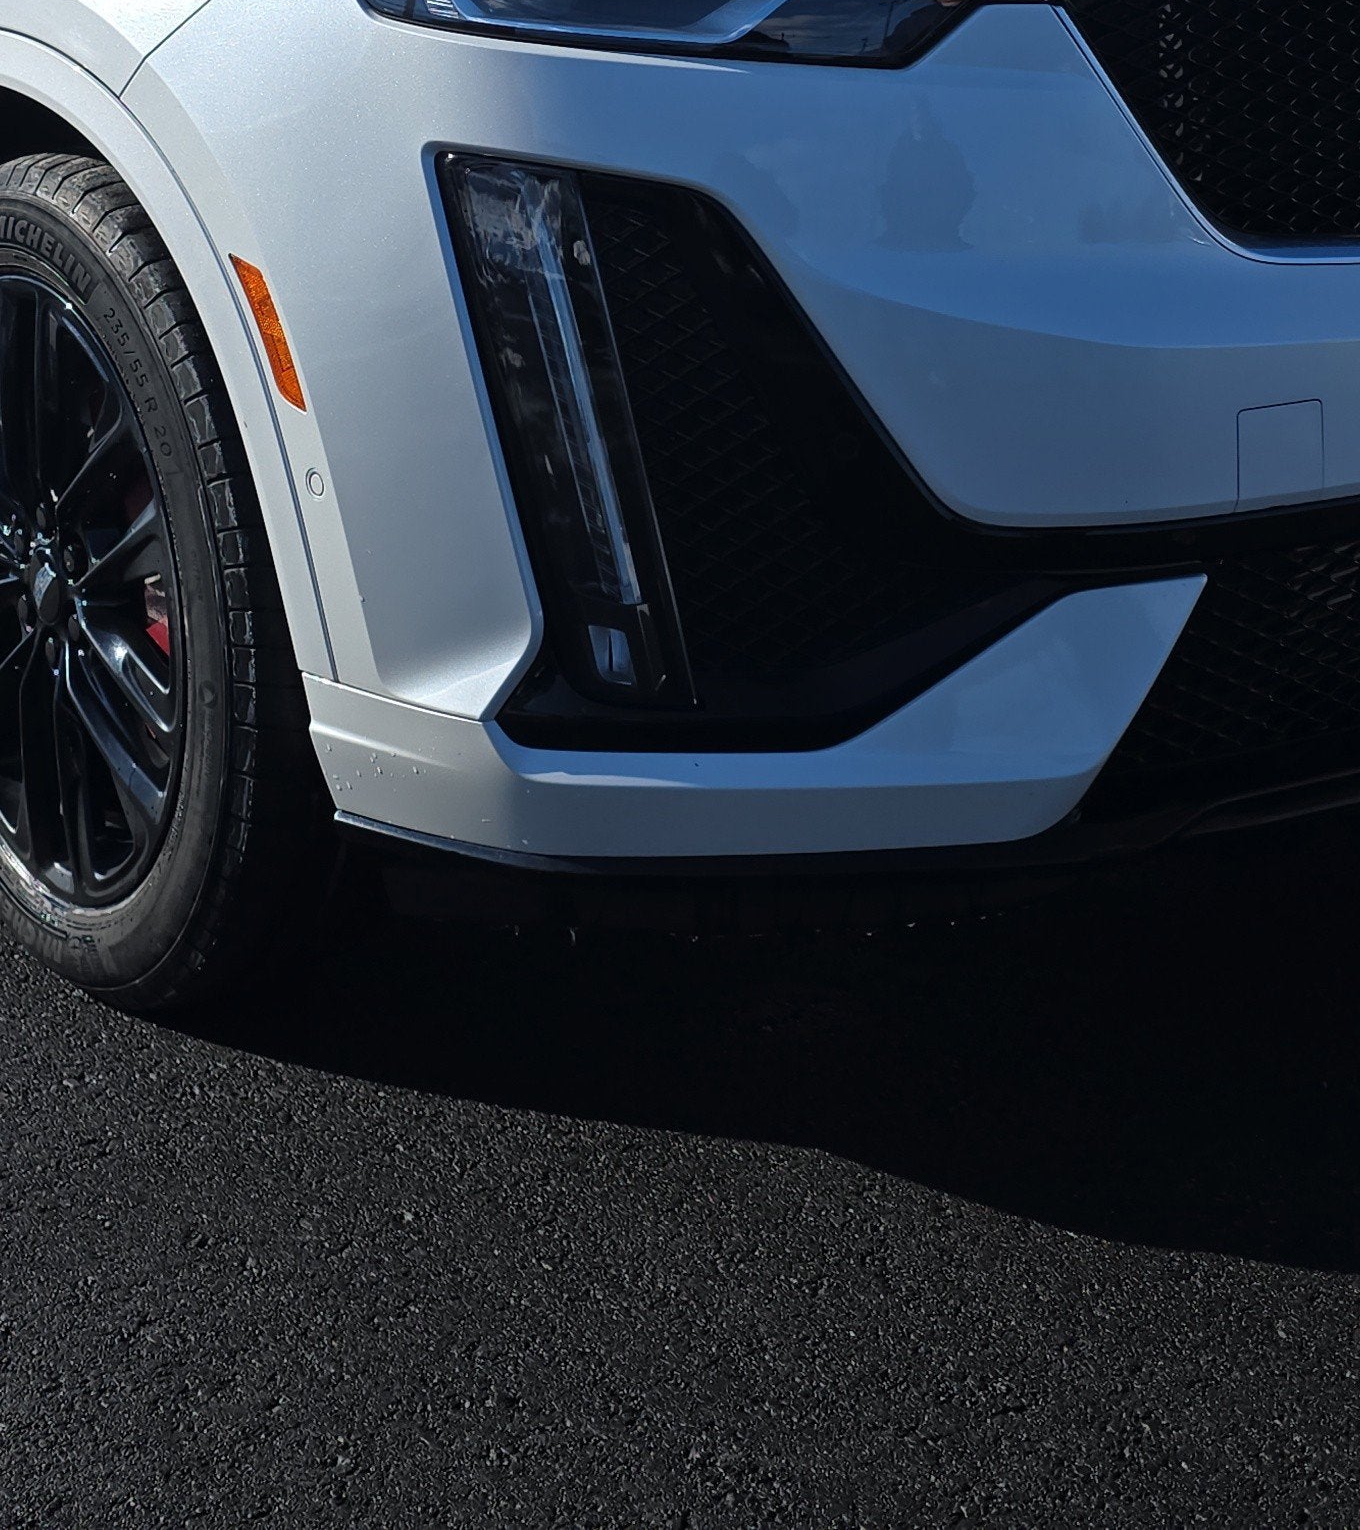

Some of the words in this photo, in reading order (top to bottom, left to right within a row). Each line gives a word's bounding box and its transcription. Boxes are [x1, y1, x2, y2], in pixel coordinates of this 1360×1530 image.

[103, 307, 149, 388] 235/55
[144, 396, 158, 413] R
[153, 425, 173, 457] 20
